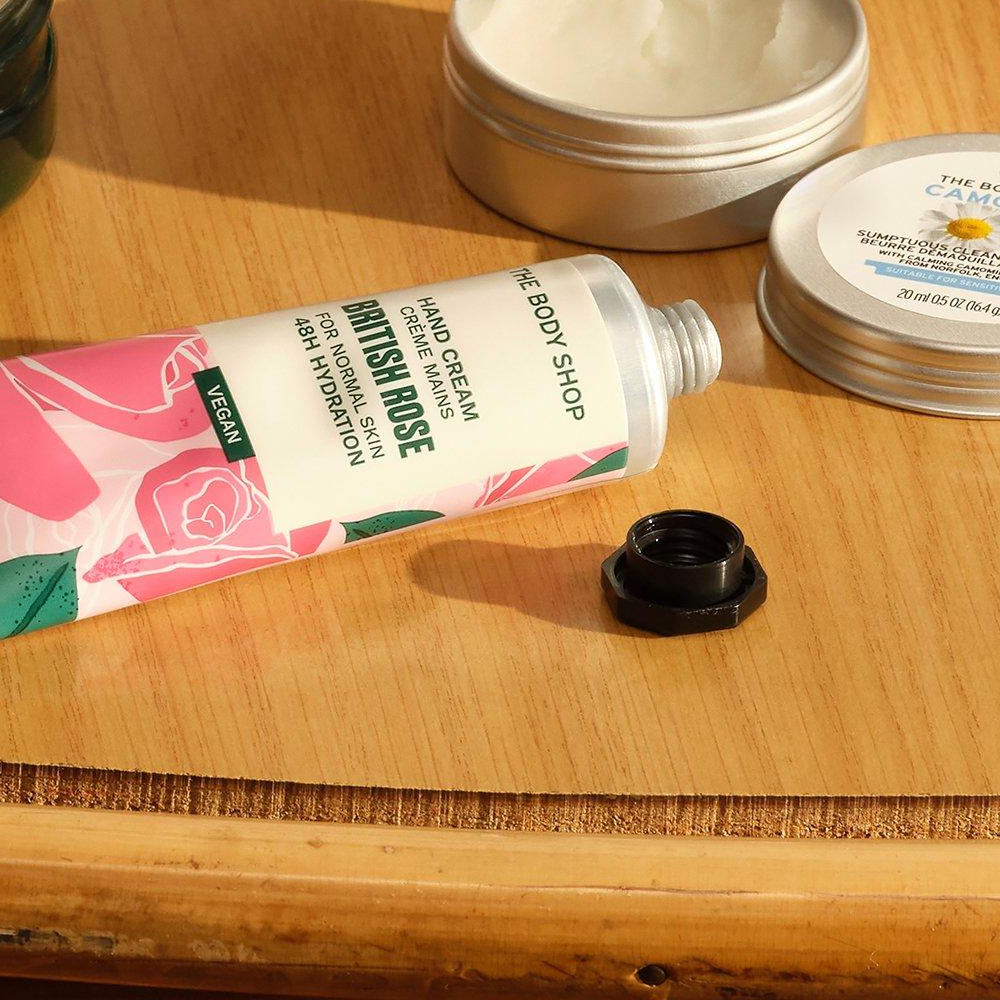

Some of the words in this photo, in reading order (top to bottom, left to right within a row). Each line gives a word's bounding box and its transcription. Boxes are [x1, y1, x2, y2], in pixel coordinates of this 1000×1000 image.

[941, 175, 976, 188] THE
[857, 229, 949, 251] SUMPTUOUS
[860, 237, 916, 252] BEURRE
[879, 249, 906, 259] WITH
[907, 254, 954, 267] CALMING
[956, 263, 1000, 276] CAMOMI
[885, 266, 936, 281] SUITABLE
[936, 274, 959, 284] FOR
[959, 279, 1000, 292] SENSITI
[899, 259, 929, 269] FROM
[930, 264, 982, 278] NORFOLK,
[897, 288, 914, 300] 20
[913, 292, 931, 303] ml
[949, 297, 966, 309] OZ
[991, 306, 1000, 317] g
[400, 305, 433, 360] CRÈME
[423, 363, 455, 420] MAINS
[417, 296, 452, 345] HAND
[441, 348, 480, 423] CREAM
[509, 267, 541, 291] THE
[527, 293, 568, 348] BODY
[552, 353, 586, 421] SHOP
[294, 317, 321, 351] 48H
[310, 354, 366, 467] HYDRATION
[315, 311, 339, 341] FOR
[330, 343, 363, 414] NORMAL
[359, 416, 386, 460] SKIN
[341, 299, 412, 386] BRITISH
[380, 383, 436, 459] ROSE
[206, 384, 243, 445] VEGAN
